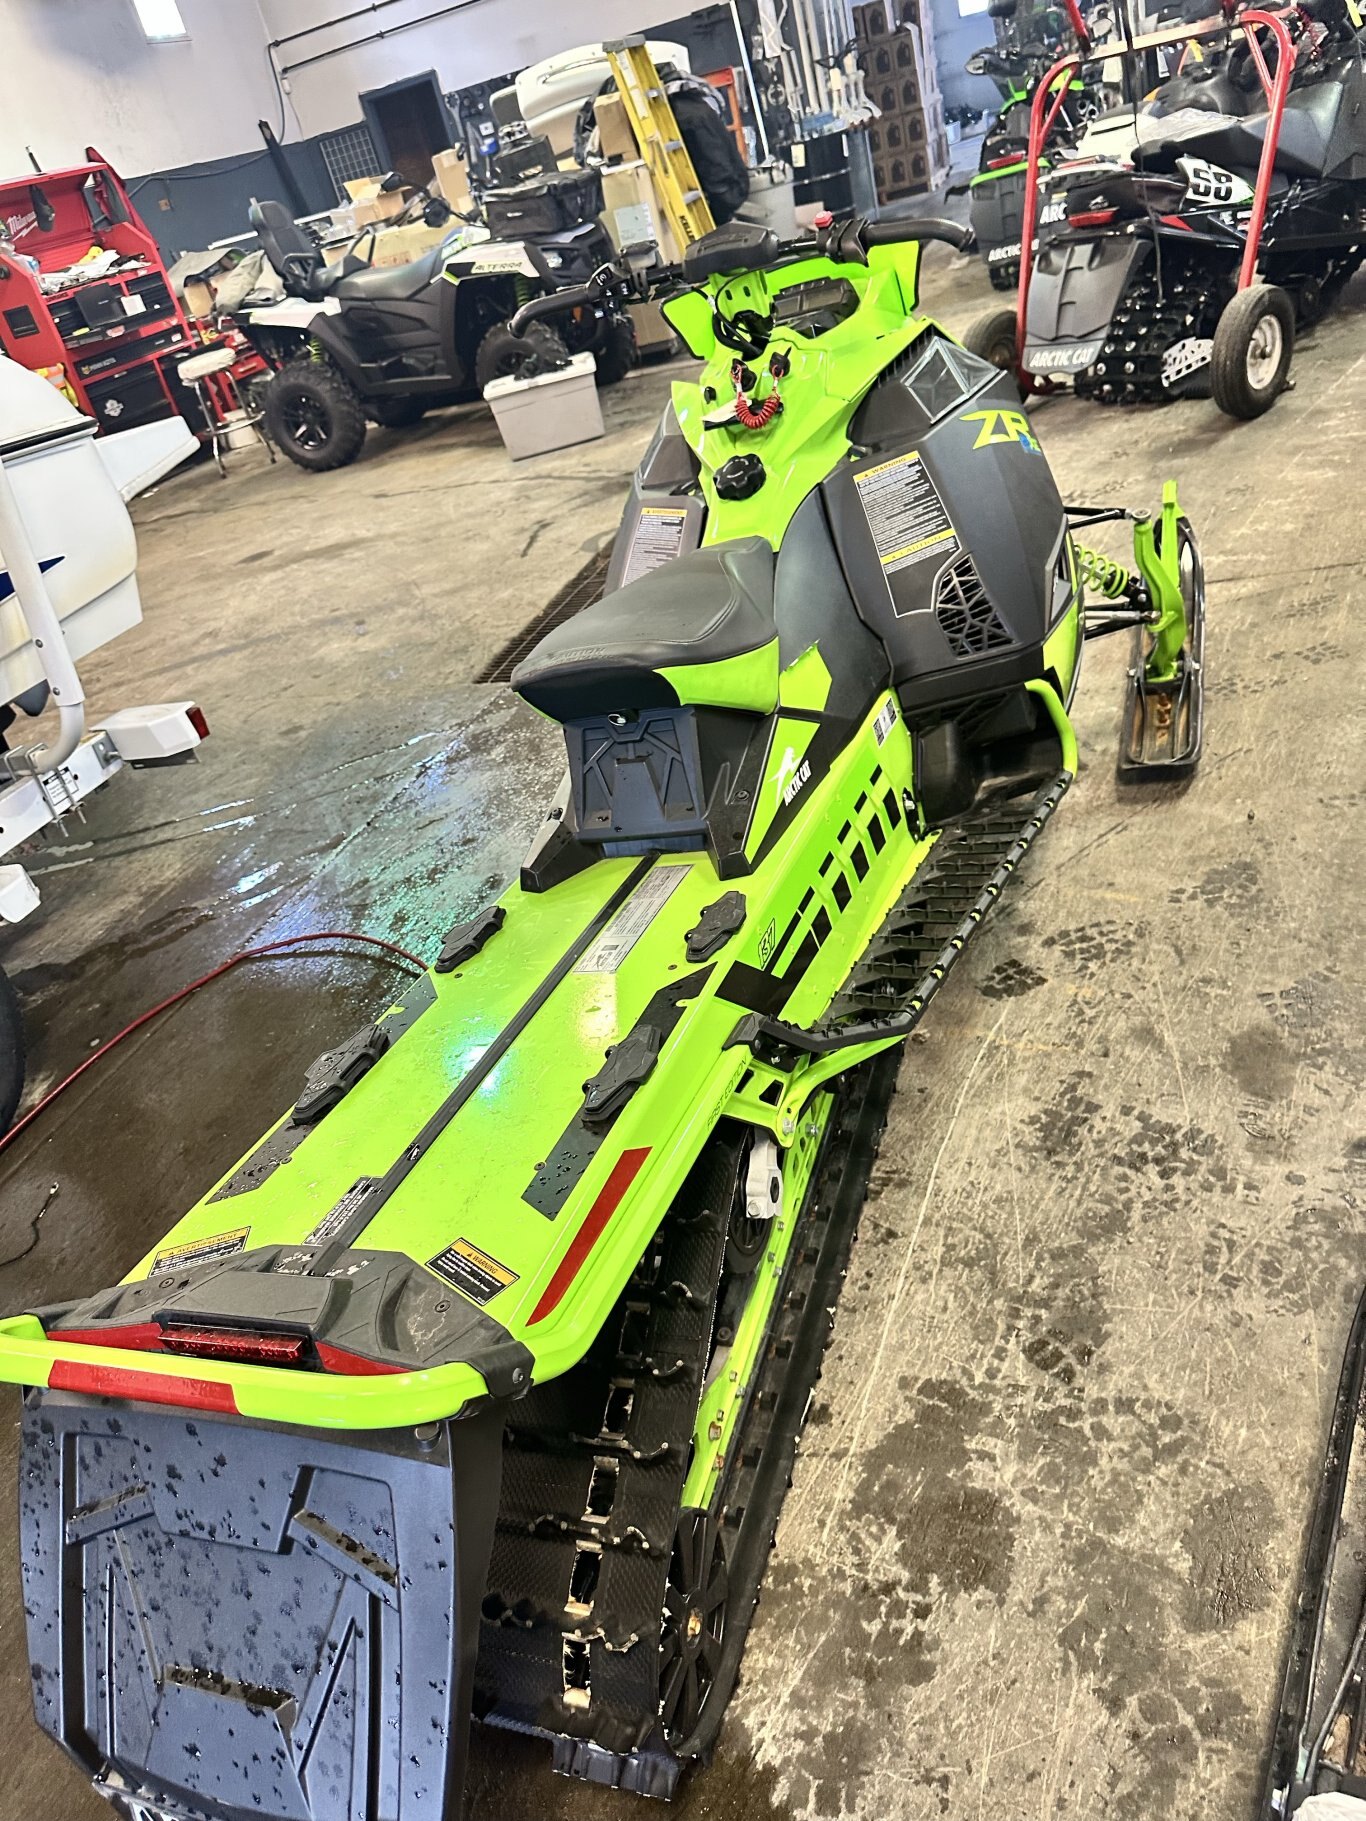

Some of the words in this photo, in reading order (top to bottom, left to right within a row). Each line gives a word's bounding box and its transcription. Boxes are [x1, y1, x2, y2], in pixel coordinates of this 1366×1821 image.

[1192, 168, 1232, 201] 58
[475, 262, 523, 271] ALTERRA
[1030, 350, 1070, 367] ARCTIC
[1072, 347, 1095, 364] CAT
[959, 409, 1031, 450] ZR
[872, 457, 910, 475] WARNING
[900, 534, 943, 556] CAUTION
[782, 769, 800, 807] ARCTIC
[799, 758, 812, 783] CAT
[472, 1254, 499, 1275] WARNING
